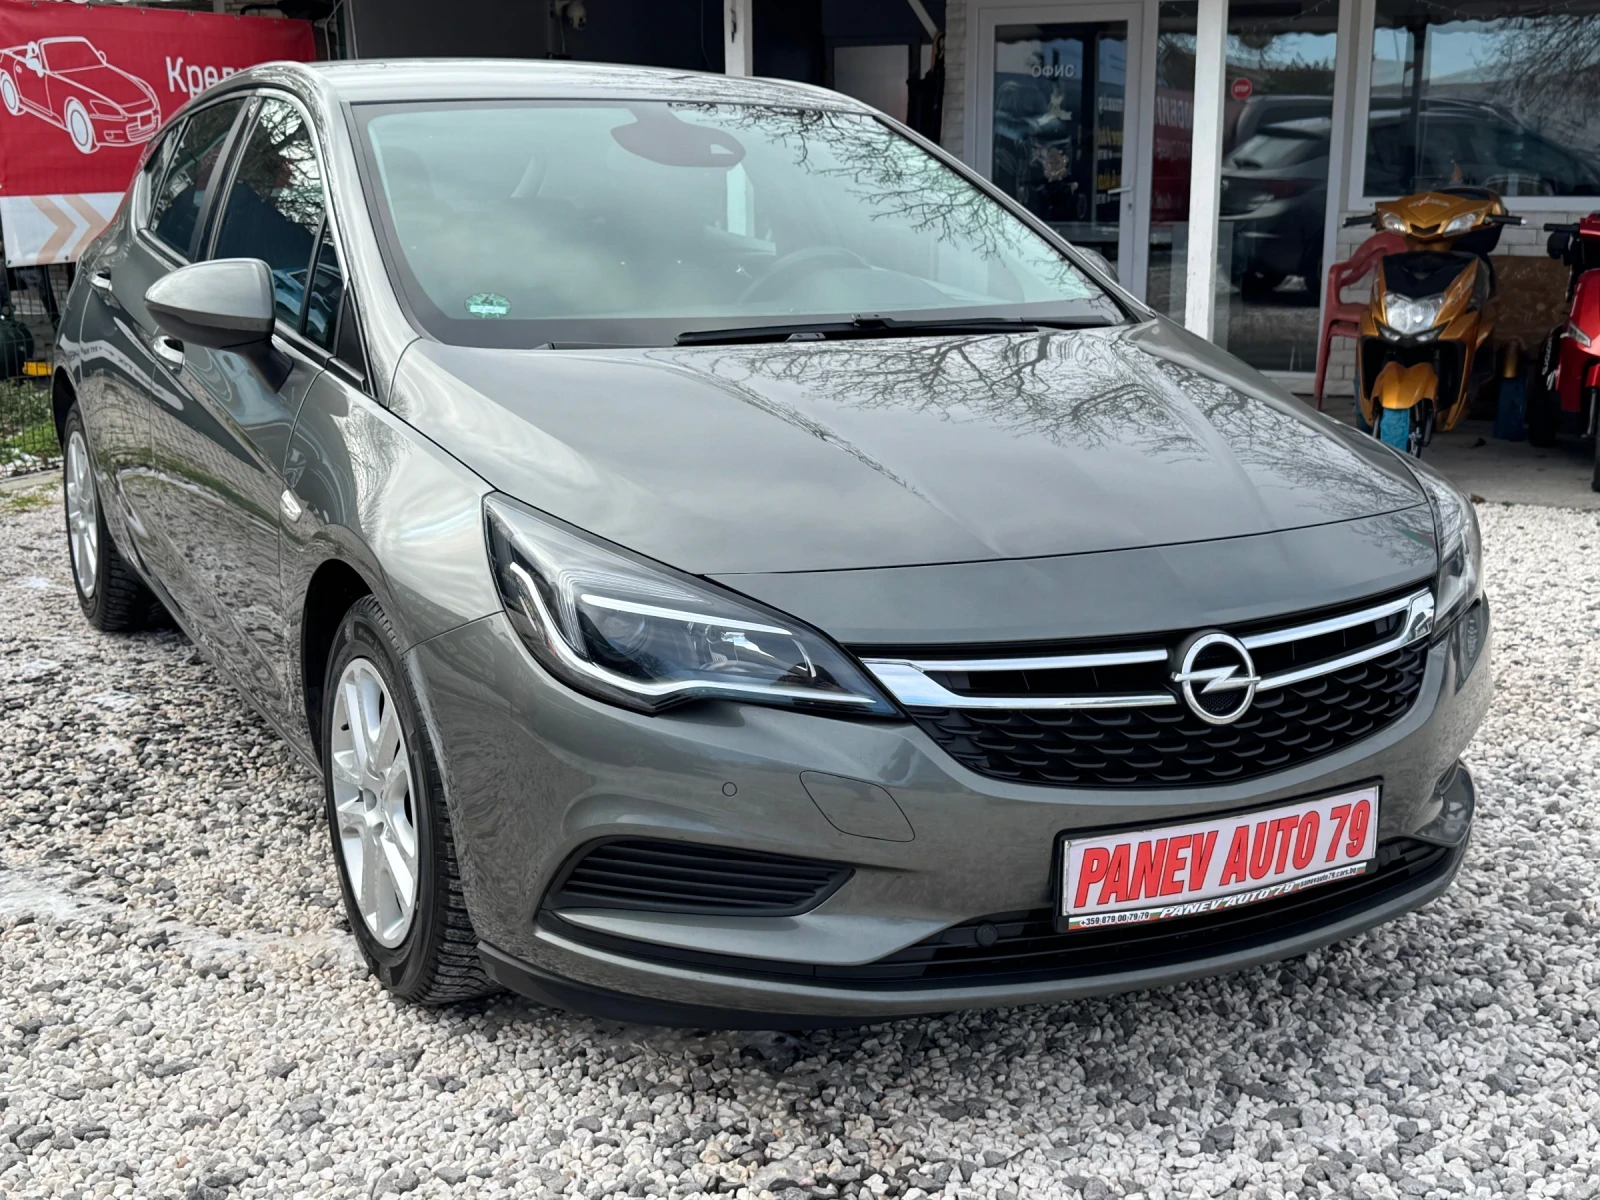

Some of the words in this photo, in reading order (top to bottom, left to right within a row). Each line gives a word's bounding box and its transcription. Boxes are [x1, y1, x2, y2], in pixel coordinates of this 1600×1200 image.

[1031, 64, 1075, 78] ОФИС
[1234, 84, 1249, 93] STOP
[1073, 830, 1218, 908] PANEV
[1219, 810, 1320, 887] AUTO
[1325, 799, 1371, 863] 79
[1081, 916, 1099, 926] +359
[1102, 914, 1116, 924] 879
[1118, 913, 1127, 922] 00
[1129, 912, 1139, 921] 79
[1140, 911, 1150, 920] 79
[1159, 897, 1227, 918] PANEV
[1224, 887, 1270, 907] AUTO
[1272, 881, 1295, 896] 79
